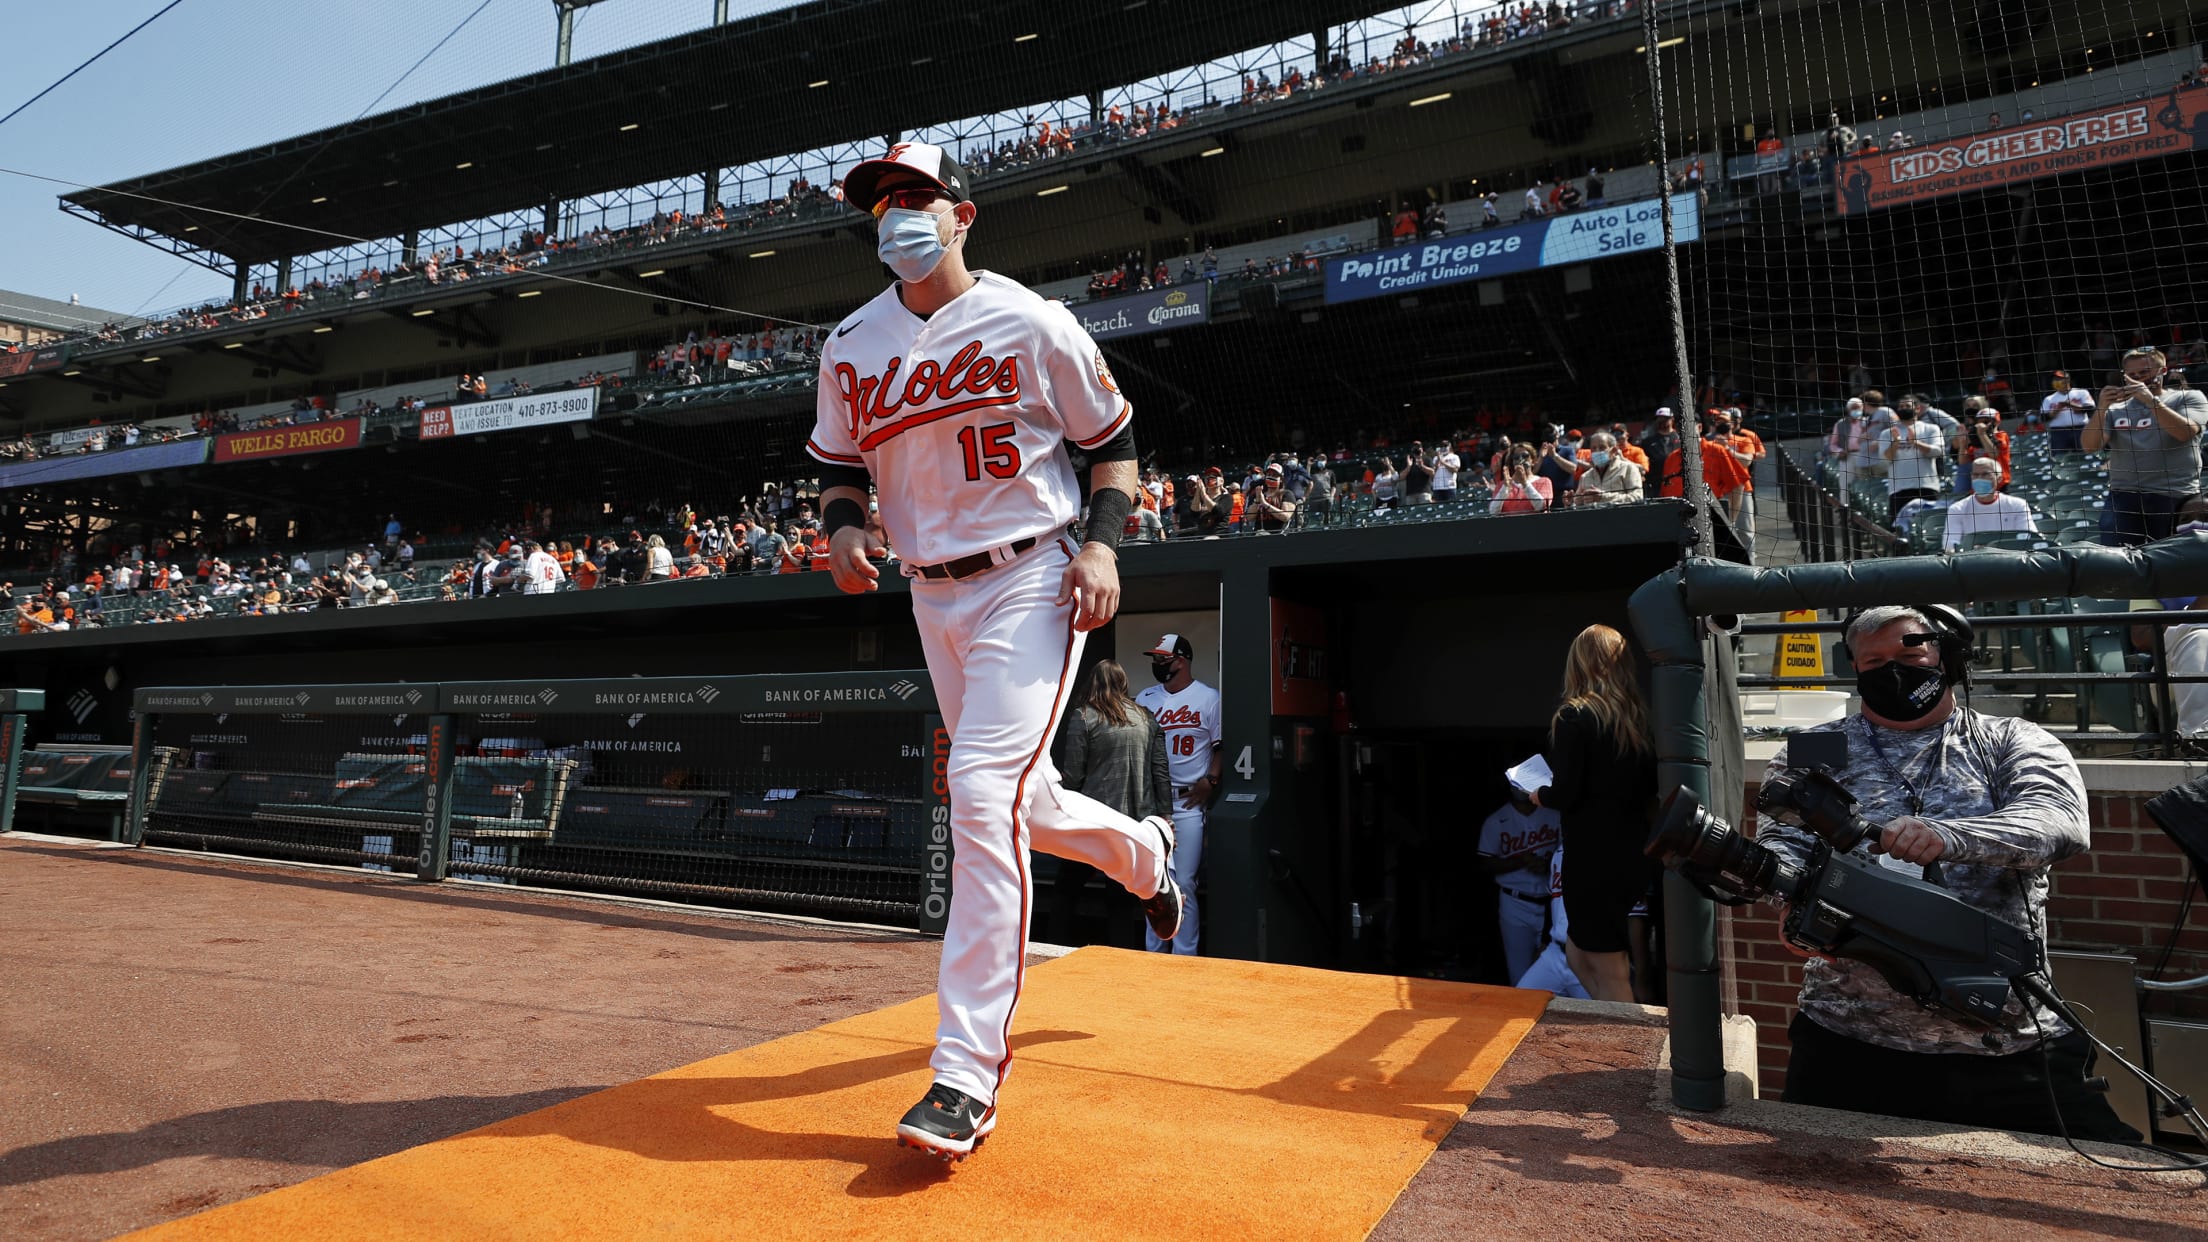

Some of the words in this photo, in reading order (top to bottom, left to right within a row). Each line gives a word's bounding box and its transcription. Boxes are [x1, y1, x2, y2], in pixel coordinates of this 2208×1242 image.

[1891, 147, 1962, 183] KIDS
[1965, 126, 2065, 167] CHEER
[2066, 107, 2148, 149] FREE
[1918, 180, 1956, 193] YOUR
[1958, 172, 1993, 186] KIDS
[2010, 161, 2041, 176] AND
[2044, 150, 2097, 170] UNDER
[2101, 143, 2133, 159] FOR
[2135, 134, 2179, 151] FREE!
[1570, 215, 1618, 234] Auto
[1626, 206, 1673, 224] Loa
[1599, 228, 1646, 252] Sale
[1340, 252, 1412, 282] Point
[1421, 235, 1521, 268] Breeze
[1379, 270, 1427, 289] Credit
[1432, 263, 1480, 280] Union
[1148, 303, 1200, 325] Corona
[835, 340, 1020, 441] Orioles
[423, 410, 446, 423] NEED
[454, 407, 473, 419] TEXT
[474, 402, 514, 418] LOCATION
[518, 397, 588, 418] 410-873-9900
[423, 423, 450, 436] HELP?
[459, 419, 475, 431] AND
[477, 416, 500, 430] ISSUE
[503, 415, 513, 427] TO
[230, 434, 284, 455] WELLS
[288, 426, 345, 448] FARGO
[958, 421, 1022, 481] 15
[1787, 643, 1815, 653] CAUTION
[1786, 657, 1816, 668] CUIDADO
[235, 697, 253, 706] BANK
[254, 697, 263, 706] OF
[263, 697, 295, 706] AMERICA
[335, 696, 357, 706] BANK
[357, 696, 369, 705] OF
[369, 695, 405, 705] AMERICA
[453, 695, 479, 705] BANK
[480, 695, 493, 705] OF
[493, 694, 536, 705] AMERICA
[595, 693, 624, 704] BANK
[626, 693, 641, 704] OF
[643, 692, 694, 704] AMERICA
[765, 690, 801, 702] BANK
[803, 689, 821, 702] OF
[823, 688, 887, 701] AMERICA
[584, 740, 612, 751] BANK
[615, 740, 628, 751] OF
[631, 741, 682, 753] AMERICA
[1172, 734, 1195, 756] 18
[1234, 745, 1255, 780] 4
[419, 725, 441, 868] Orioles.com
[925, 728, 950, 919] Orioles.com
